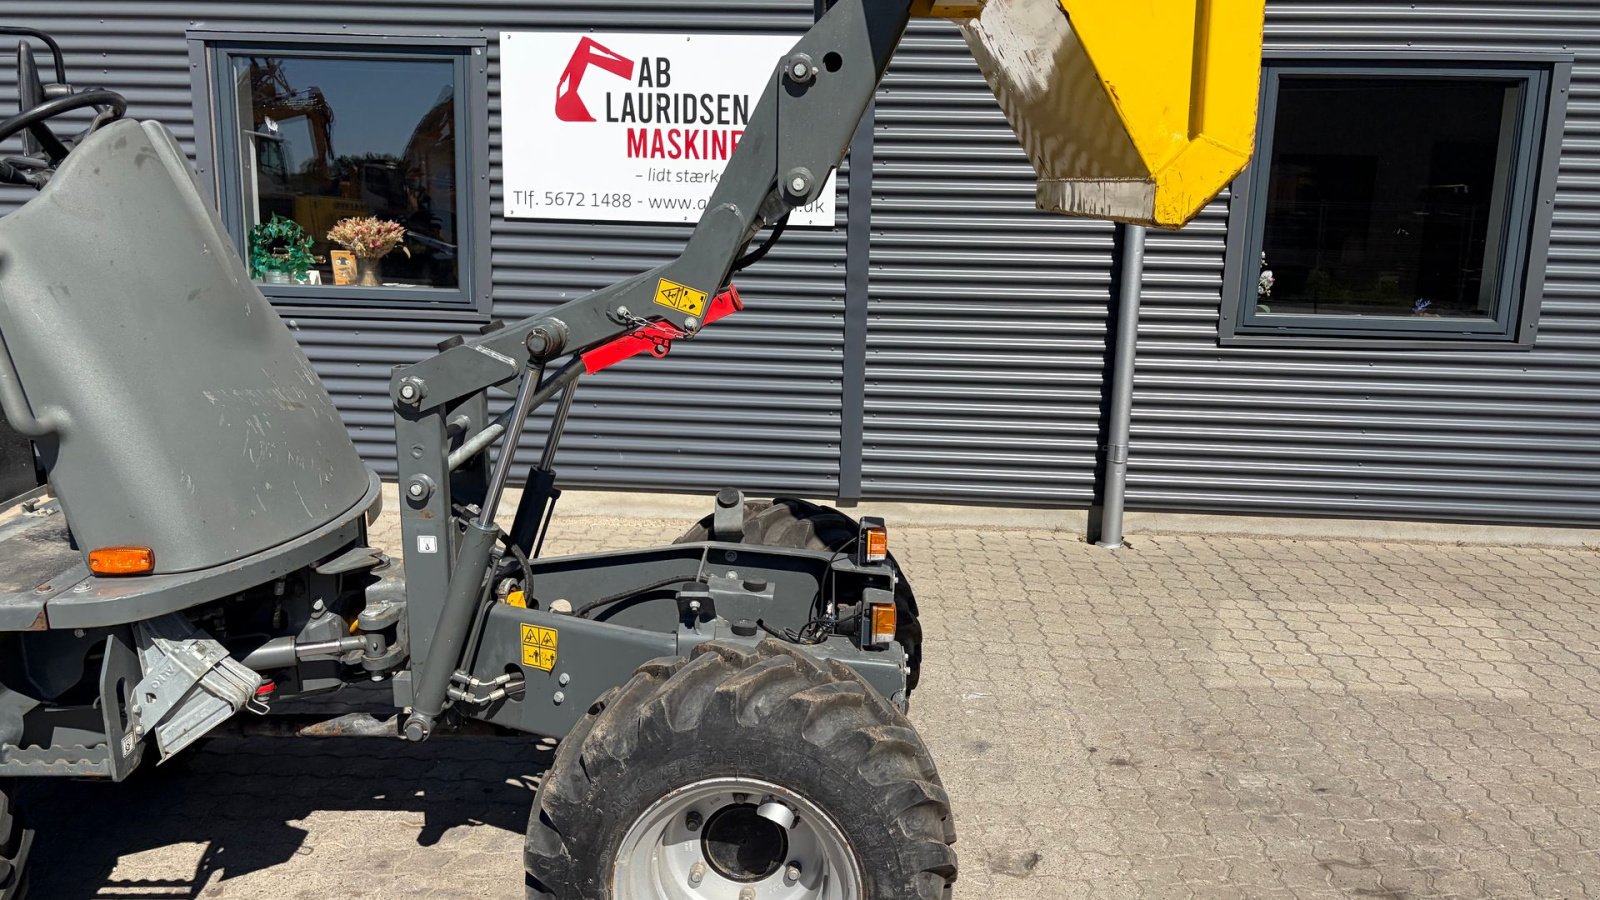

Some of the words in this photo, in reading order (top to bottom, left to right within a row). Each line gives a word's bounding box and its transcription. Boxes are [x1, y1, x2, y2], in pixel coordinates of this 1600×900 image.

[638, 56, 671, 88] AB
[606, 92, 749, 126] LAURIDSEN
[648, 168, 672, 182] lidt
[513, 190, 539, 209] Tlf.
[544, 191, 586, 207] 5672
[590, 193, 632, 208] 1488
[648, 195, 712, 210] www.a
